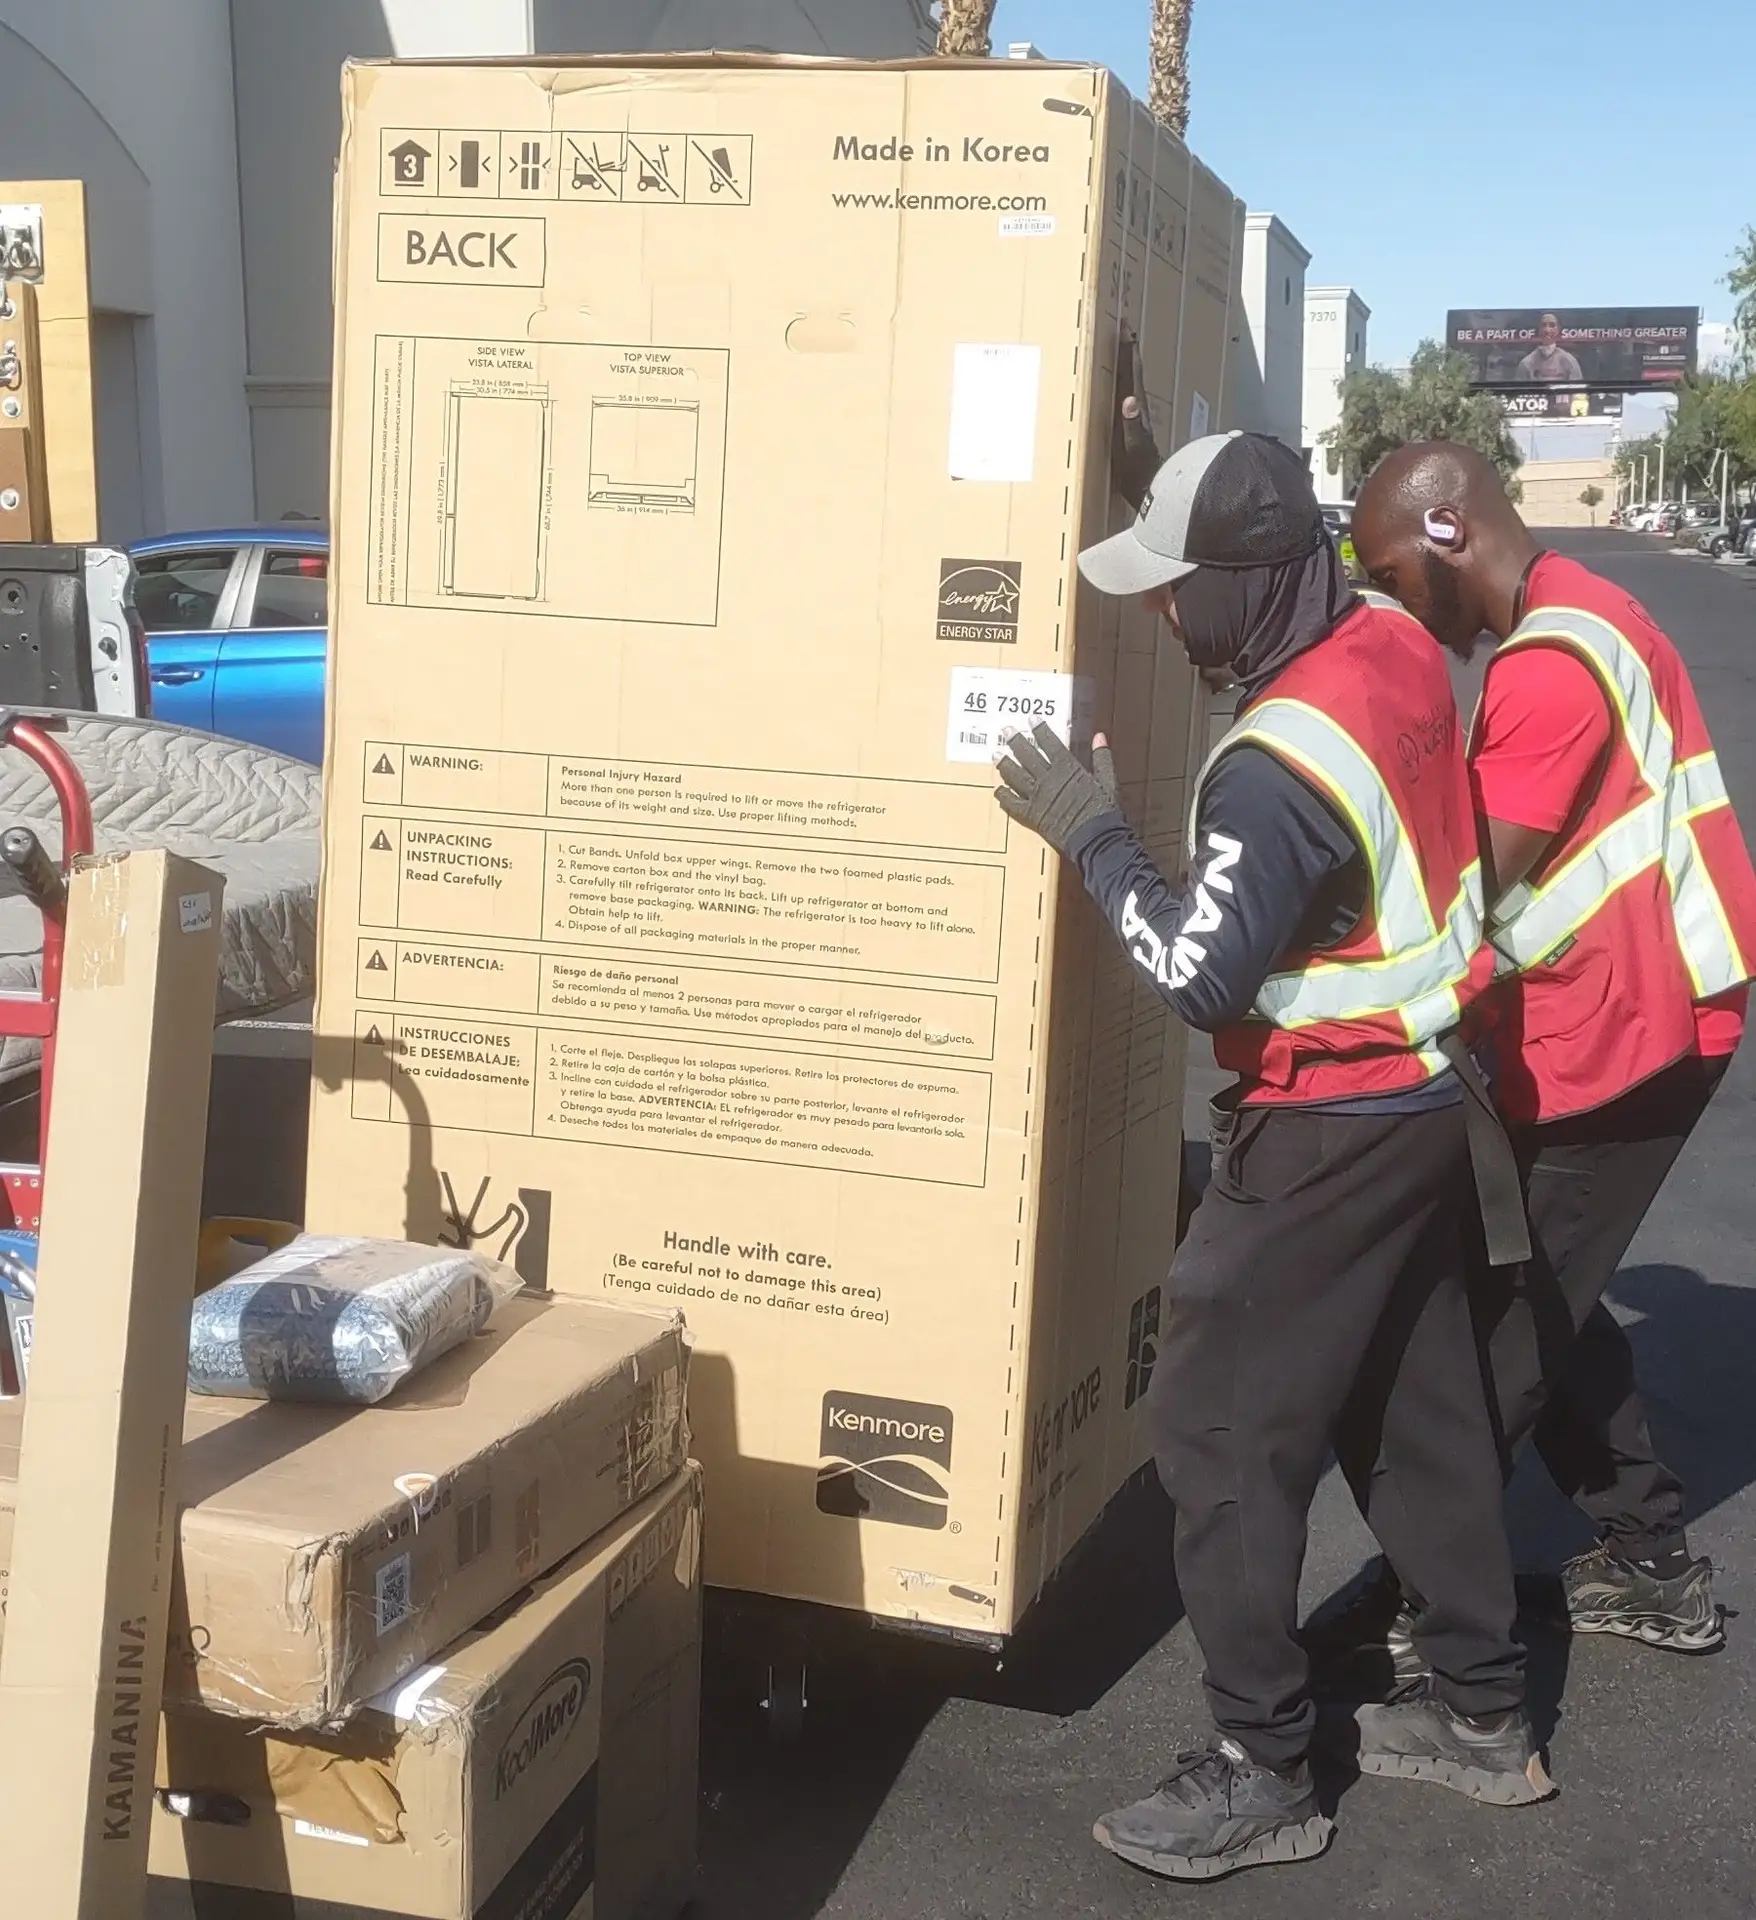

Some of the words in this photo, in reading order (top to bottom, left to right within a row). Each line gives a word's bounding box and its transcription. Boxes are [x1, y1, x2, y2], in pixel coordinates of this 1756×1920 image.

[832, 136, 914, 162] Made
[925, 137, 950, 162] in
[962, 137, 1050, 163] Korea
[832, 188, 1047, 211] www.kenmore.com
[406, 230, 518, 269] BACK
[1309, 311, 1337, 322] 7370
[1457, 329, 1473, 340] BE
[1475, 329, 1484, 340] A
[1486, 329, 1516, 340] PART
[1519, 328, 1536, 339] OF
[1561, 327, 1632, 339] SOMETHING
[1634, 326, 1688, 338] GREATER
[477, 346, 498, 356] SIDE
[500, 347, 525, 357] VIEW
[623, 352, 644, 362] TOP
[645, 353, 671, 364] VIEW
[468, 358, 494, 368] VISTA
[496, 359, 534, 371] LATERAL
[609, 364, 637, 375] VISTA
[638, 365, 684, 377] SUPERIOR
[940, 625, 983, 639] ENERGY
[984, 626, 1013, 641] STAR
[964, 692, 987, 709] 46
[997, 696, 1056, 716] 73025
[409, 754, 484, 772] WARNING:
[561, 765, 606, 778] Personal
[609, 768, 641, 783] Injury
[643, 771, 682, 784] Hazard
[560, 780, 588, 793] More
[590, 783, 614, 794] than
[615, 787, 635, 796] one
[637, 788, 672, 799] person
[674, 789, 683, 800] is
[685, 791, 728, 803] required
[731, 794, 742, 804] to
[744, 794, 759, 805] lift
[761, 798, 774, 806] or
[775, 799, 805, 809] move
[807, 799, 824, 810] the
[826, 800, 887, 815] refrigerator
[560, 795, 602, 808] because
[604, 799, 617, 809] of
[618, 800, 630, 811] its
[632, 802, 667, 815] weight
[669, 804, 690, 815] and
[692, 806, 715, 817] size.
[717, 807, 737, 819] Use
[739, 811, 775, 823] proper
[777, 812, 808, 826] lifting
[810, 815, 858, 828] methods.
[407, 830, 493, 849] UNPACKING
[406, 849, 513, 870] INSTRUCTIONS:
[558, 843, 566, 855] 1.
[567, 844, 586, 856] Cut
[588, 846, 623, 859] Bands.
[625, 849, 661, 862] Unfold
[663, 852, 683, 863] box
[685, 856, 717, 868] upper
[719, 857, 753, 871] wings.
[755, 859, 797, 873] Remove
[800, 863, 817, 874] the
[819, 866, 840, 876] two
[842, 866, 884, 880] foamed
[886, 871, 923, 883] plastic
[924, 874, 955, 886] pads.
[405, 868, 439, 882] Read
[442, 871, 503, 890] Carefully
[556, 858, 567, 869] 2.
[569, 859, 611, 873] Remove
[612, 865, 646, 876] carton
[648, 865, 669, 878] box
[671, 869, 693, 879] and
[695, 869, 712, 881] the
[714, 872, 739, 885] vinyl
[742, 873, 767, 888] bag.
[555, 873, 567, 884] 3.
[568, 874, 617, 890] Carefully
[618, 879, 632, 890] tilt
[635, 881, 695, 895] refrigerator
[697, 887, 722, 897] onto
[724, 887, 736, 899] its
[738, 889, 768, 902] back.
[770, 891, 788, 903] Lift
[790, 895, 805, 906] up
[807, 895, 869, 910] refrigerator
[871, 902, 883, 911] at
[885, 901, 924, 915] bottom
[926, 906, 949, 917] and
[568, 892, 607, 903] remove
[609, 892, 635, 905] base
[637, 896, 695, 912] packaging.
[697, 900, 761, 916] WARNING:
[763, 906, 782, 917] The
[784, 908, 847, 923] refrigerator
[848, 913, 857, 924] is
[859, 915, 877, 926] too
[880, 916, 913, 931] heavy
[915, 921, 927, 930] to
[929, 920, 944, 932] lift
[945, 923, 976, 935] alone.
[568, 904, 605, 917] Obtain
[608, 907, 631, 922] help
[633, 911, 644, 921] to
[646, 911, 664, 923] lift.
[554, 919, 565, 929] 4.
[567, 919, 608, 933] Dispose
[609, 923, 622, 934] of
[623, 925, 637, 935] all
[639, 927, 695, 943] packaging
[697, 933, 746, 945] materials
[748, 935, 759, 946] in
[761, 937, 779, 948] the
[780, 941, 817, 953] proper
[819, 944, 861, 956] manner.
[401, 951, 504, 972] ADVERTENCIA:
[553, 964, 587, 979] Riesgo
[589, 967, 603, 979] de
[605, 969, 632, 981] daño
[634, 974, 679, 986] personal
[399, 1025, 511, 1048] INSTRUCCIONES
[398, 1040, 417, 1058] DE
[420, 1046, 521, 1068] DESEMBALAJE:
[397, 1063, 421, 1078] Lea
[424, 1066, 530, 1087] cuidadosamente
[663, 1230, 731, 1257] Handle
[737, 1241, 780, 1263] with
[785, 1251, 832, 1270] care.
[612, 1252, 638, 1269] (Be
[641, 1259, 693, 1276] careful
[697, 1266, 722, 1279] not
[725, 1267, 740, 1281] to
[744, 1269, 807, 1292] damage
[810, 1277, 837, 1294] this
[841, 1285, 882, 1303] area)
[602, 1272, 652, 1293] (Tenga
[655, 1282, 716, 1300] cuidado
[719, 1287, 740, 1303] de
[743, 1294, 762, 1306] no
[766, 1293, 811, 1312] dañar
[814, 1303, 845, 1317] esta
[849, 1305, 889, 1326] área)
[828, 1407, 945, 1443] Kenmore
[103, 1615, 147, 1840] KAMANINA
